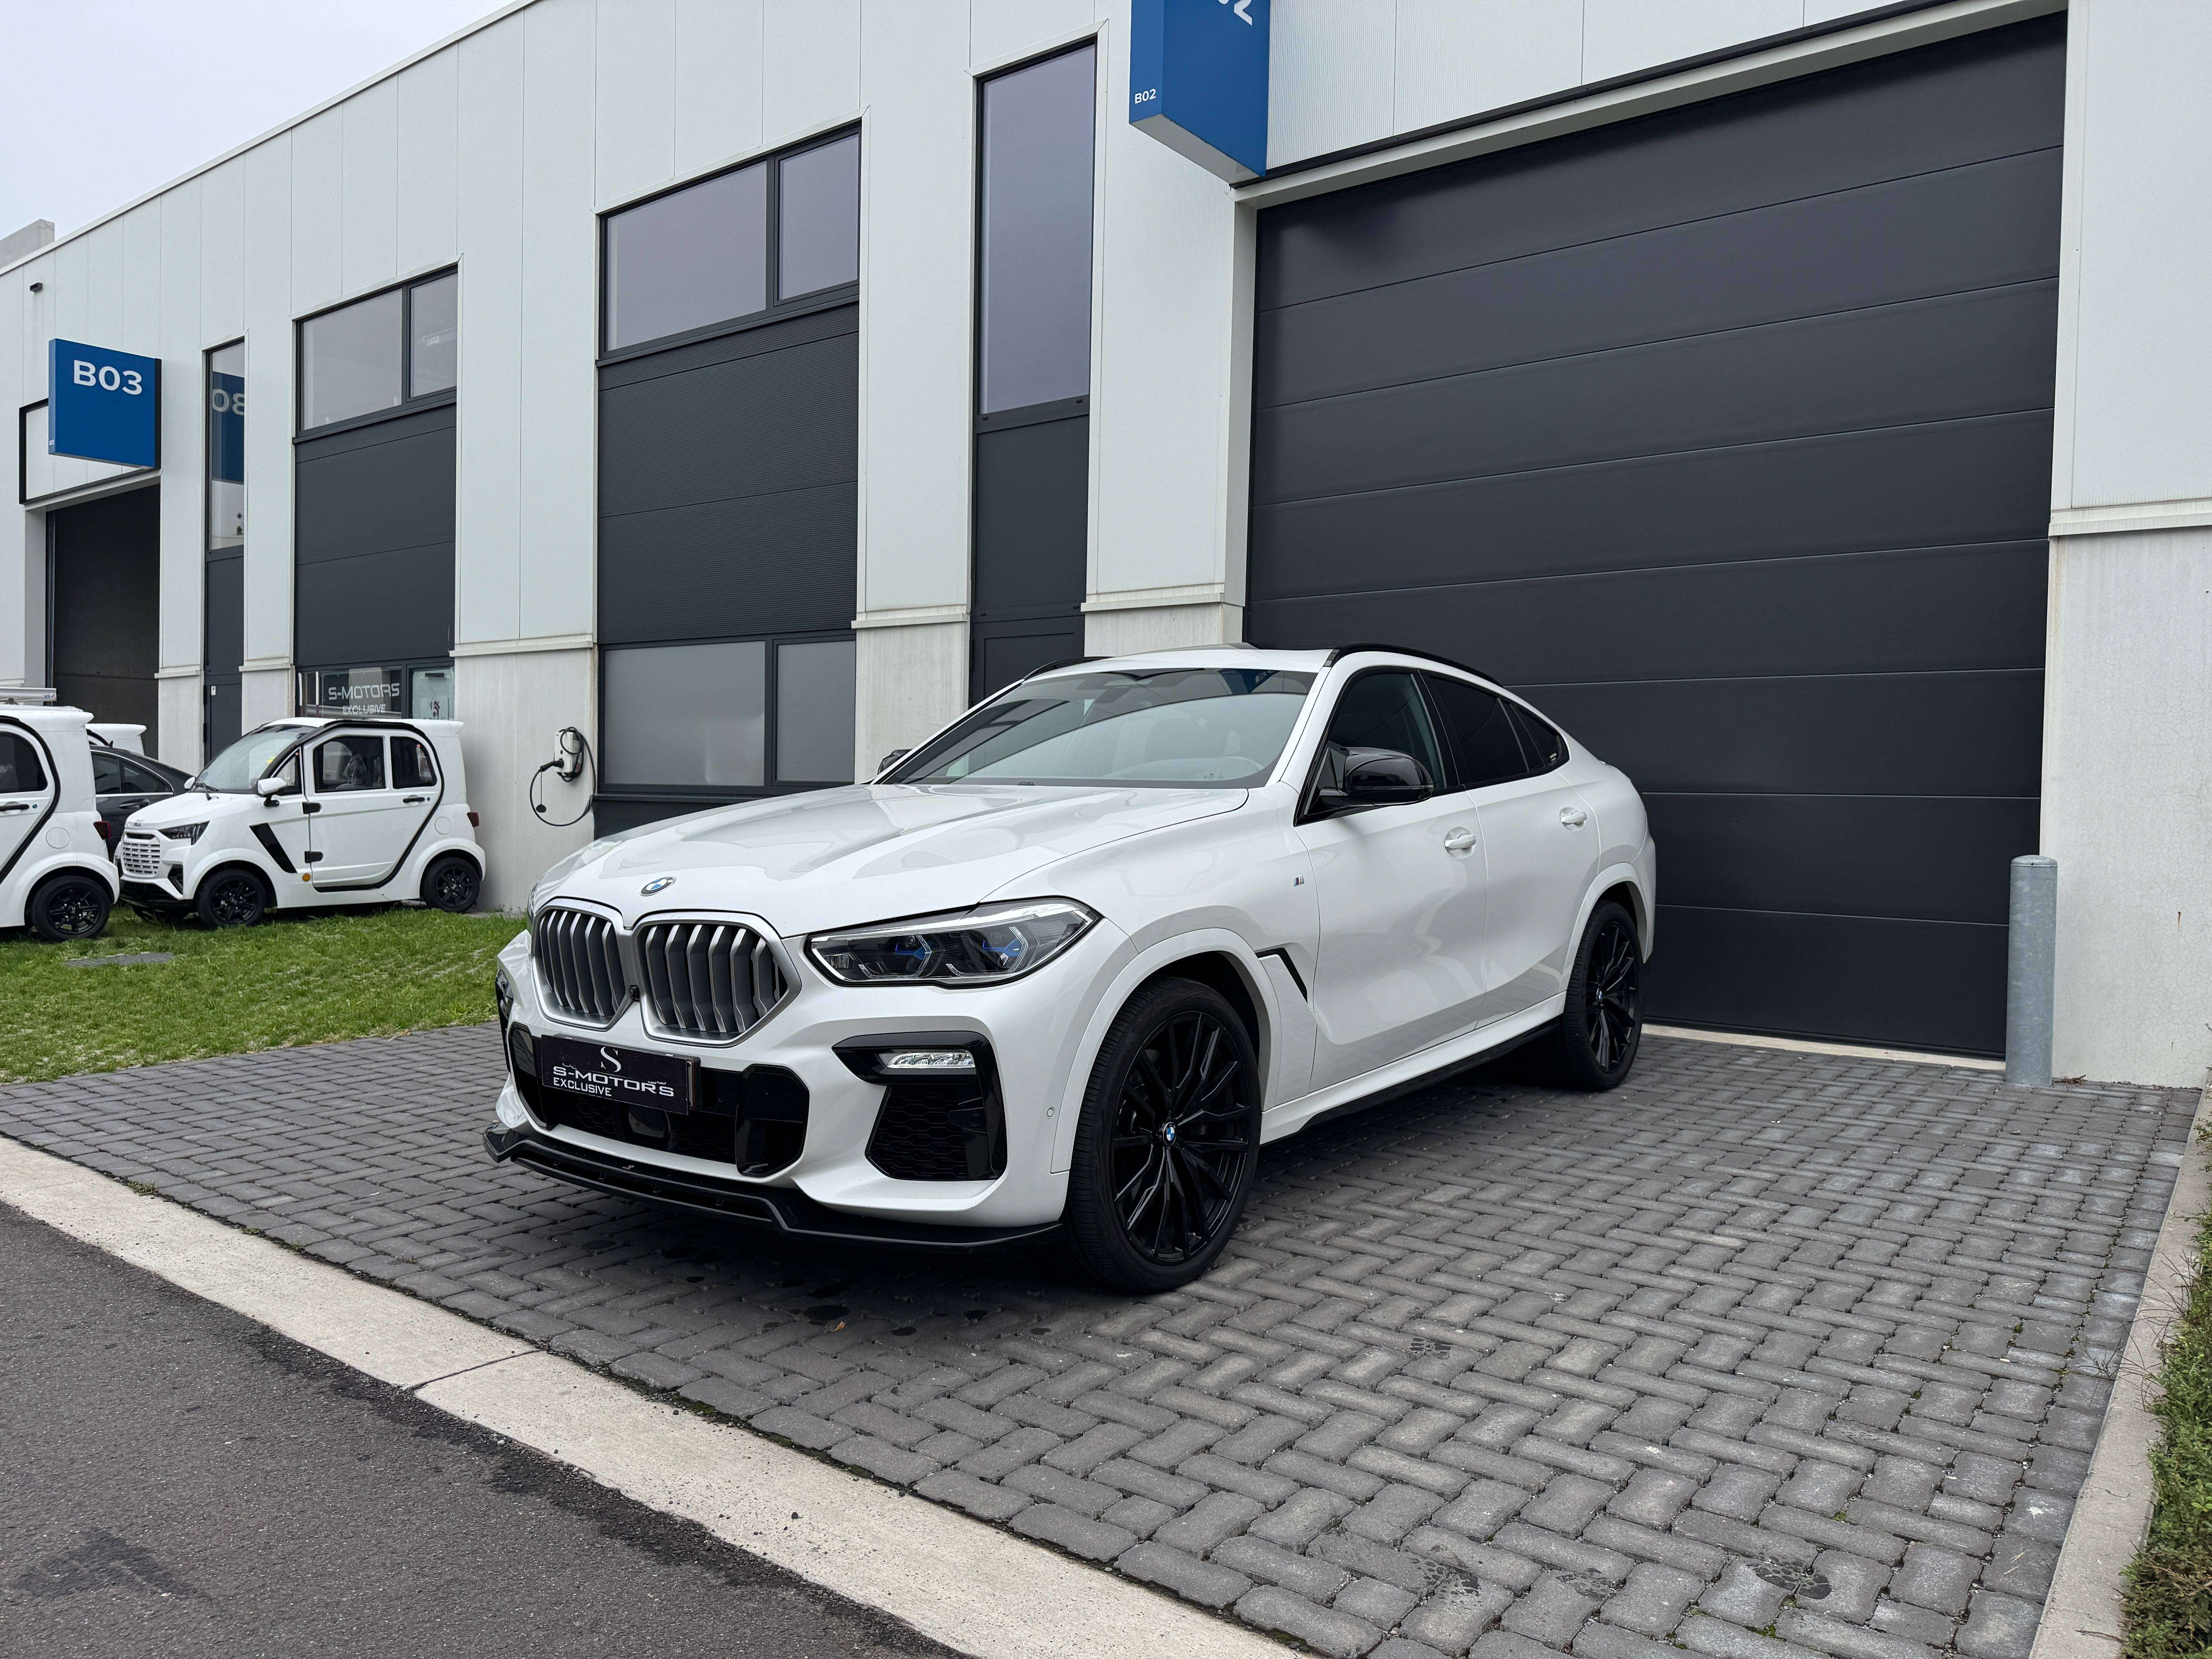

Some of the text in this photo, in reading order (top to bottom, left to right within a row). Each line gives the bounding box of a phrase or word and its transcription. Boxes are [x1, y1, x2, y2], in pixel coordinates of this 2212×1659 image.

[1135, 89, 1156, 104] B02
[74, 360, 143, 395] B03
[328, 683, 400, 700] S-MOTORS
[342, 704, 386, 715] EXCLUSIVE
[553, 1066, 674, 1097] S-MOTORS
[553, 1077, 612, 1097] EXCLUSIVE
